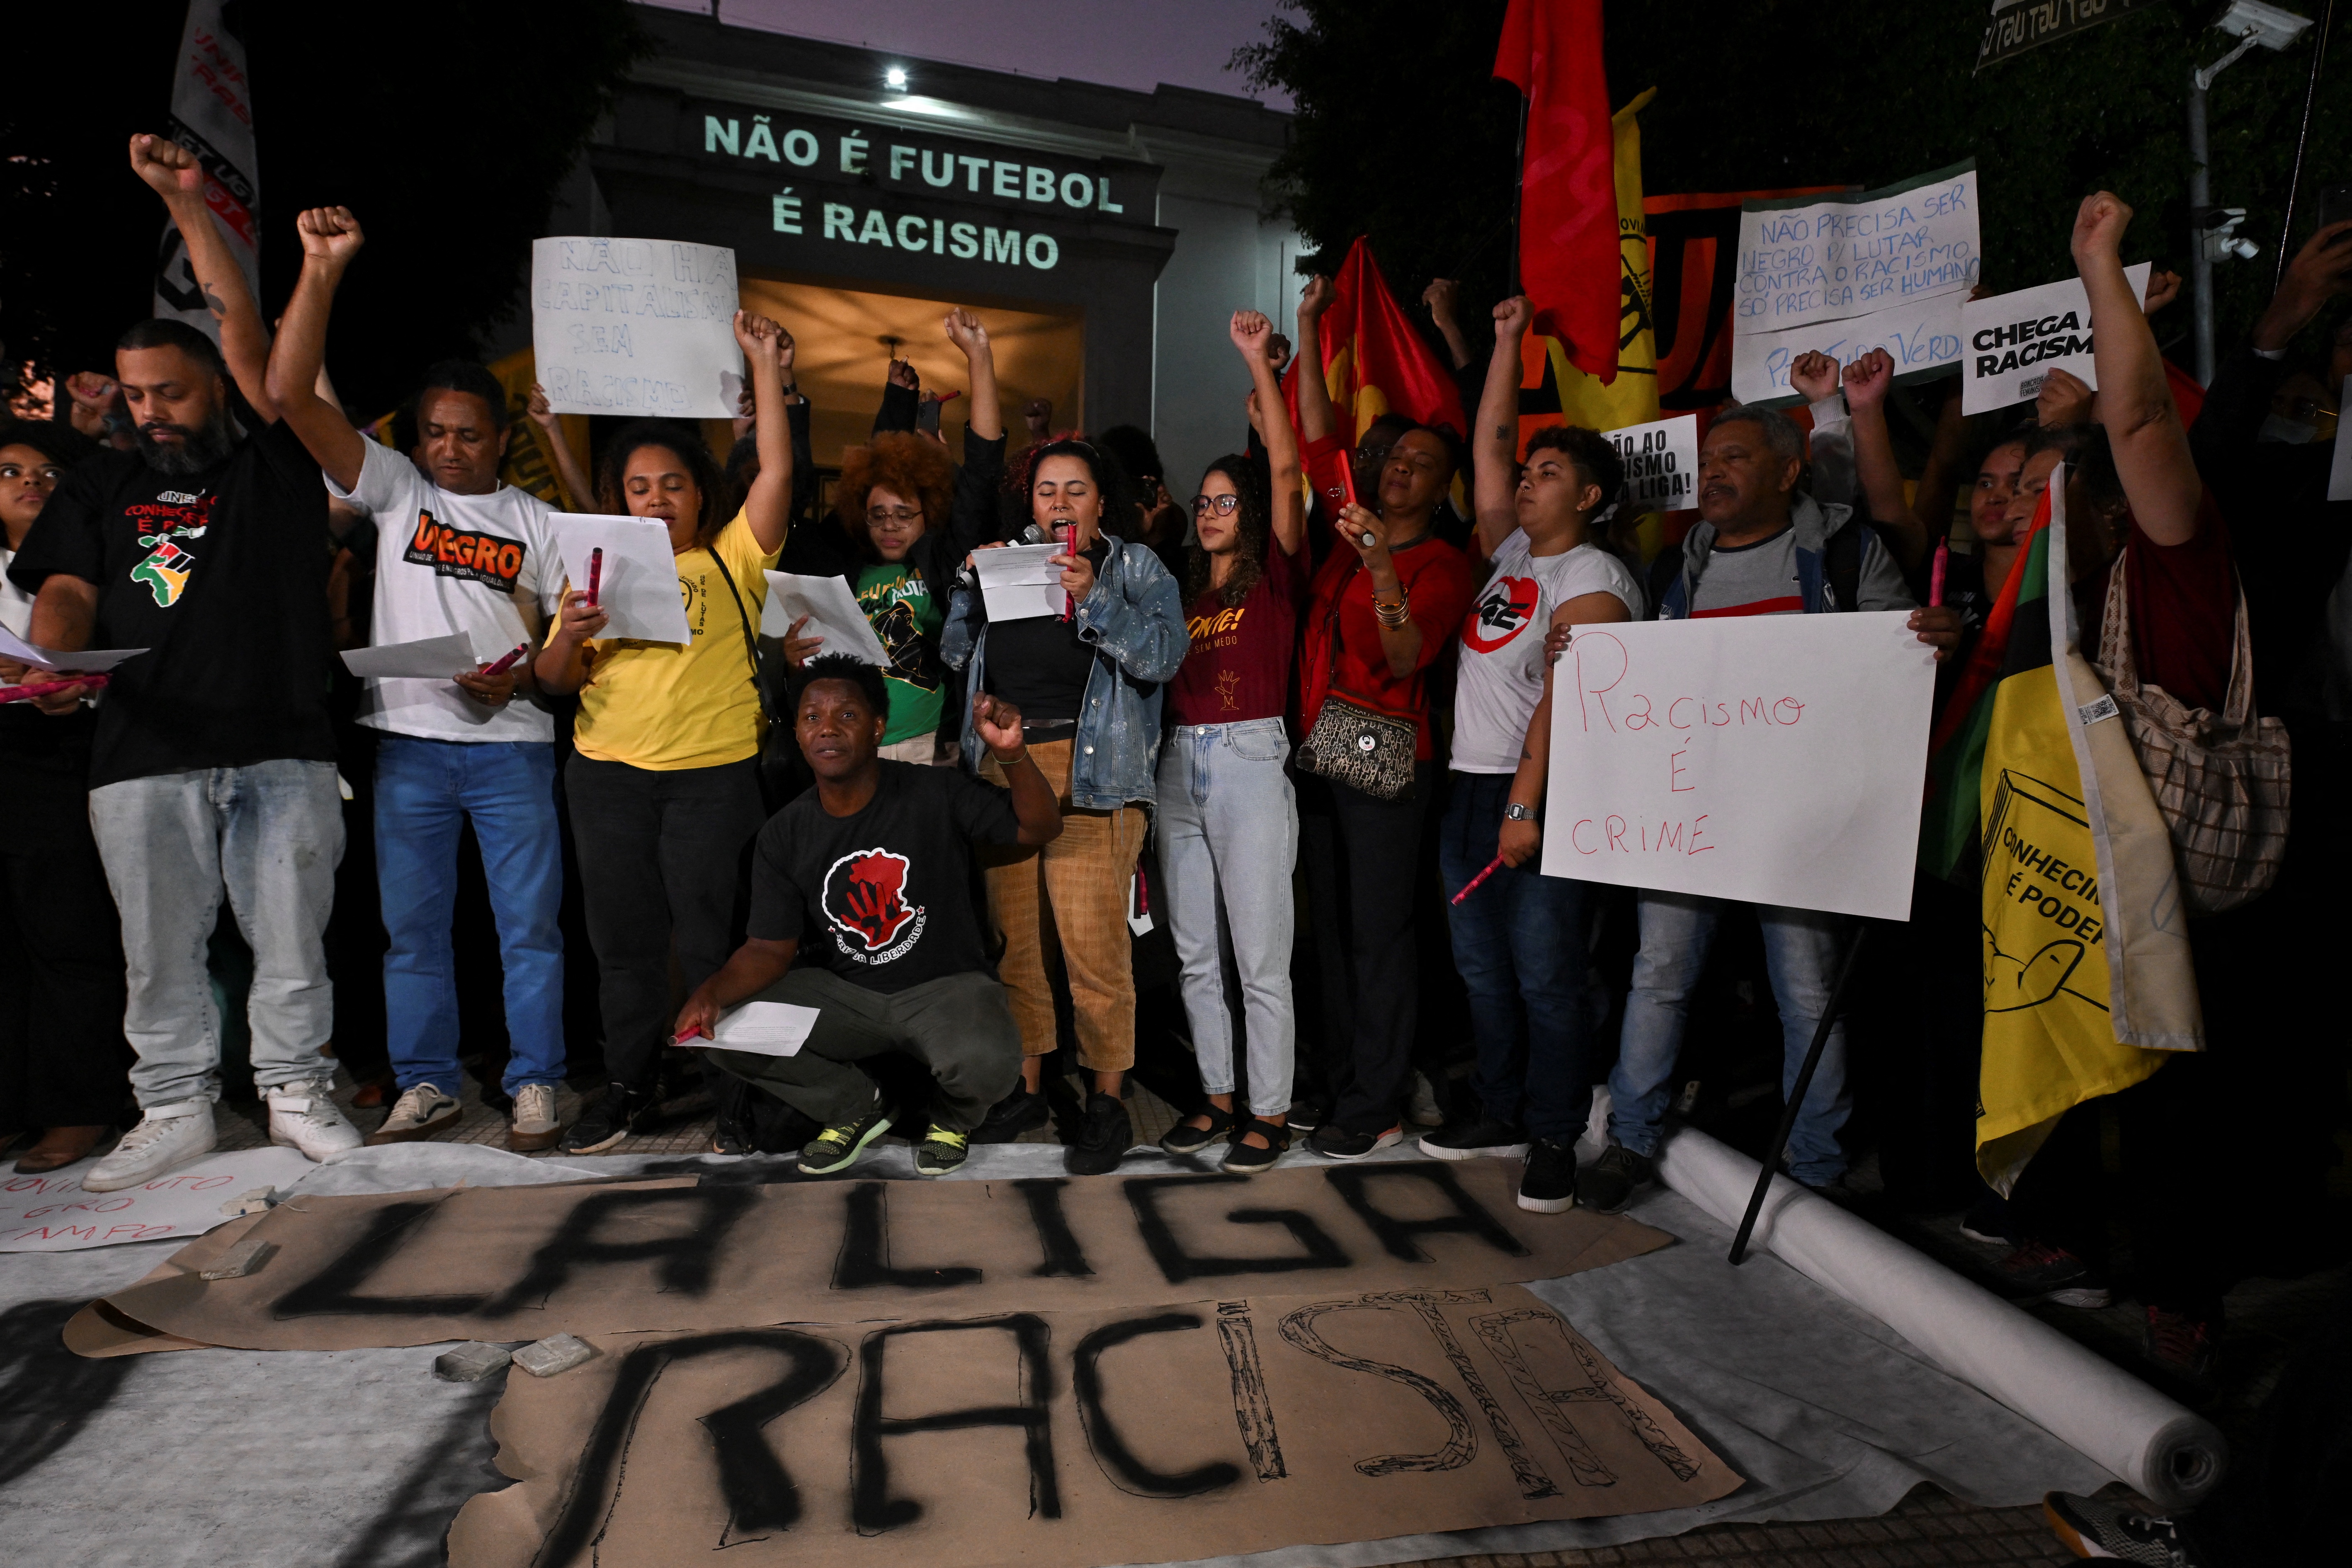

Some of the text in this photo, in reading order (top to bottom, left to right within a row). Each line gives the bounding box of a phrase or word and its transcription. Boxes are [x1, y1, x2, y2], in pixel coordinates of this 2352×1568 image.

[705, 115, 1123, 213] NÃO É FUTEBOL
[773, 187, 1058, 269] É RACISMO
[1762, 184, 1966, 245] NÃO PRECISA SER
[560, 238, 653, 277] NÃO
[1739, 241, 1968, 294] CONTRA O RACISMO
[1742, 245, 1814, 272] NEGRO
[1853, 226, 1934, 261] LUTAR
[1776, 286, 1853, 315] PRECISA
[1860, 278, 1894, 301] SER
[1901, 257, 1980, 293] HUMANO
[568, 323, 633, 357] SEM
[1973, 311, 2080, 351] CHEGA
[1976, 334, 2094, 378] RACISM
[548, 367, 691, 412] RACISMO
[2020, 386, 2041, 397] FEMINIS
[1613, 430, 1666, 456] ÃO AO
[1627, 451, 1676, 479] ISMO
[1639, 473, 1691, 500] LIGA!
[1195, 642, 1211, 654] SEM
[1214, 636, 1237, 648] MEDO
[1671, 736, 1695, 793] É
[2006, 871, 2024, 897] É
[870, 915, 926, 965] LIBERDADE
[531, 1286, 1702, 1568] RACISTA
